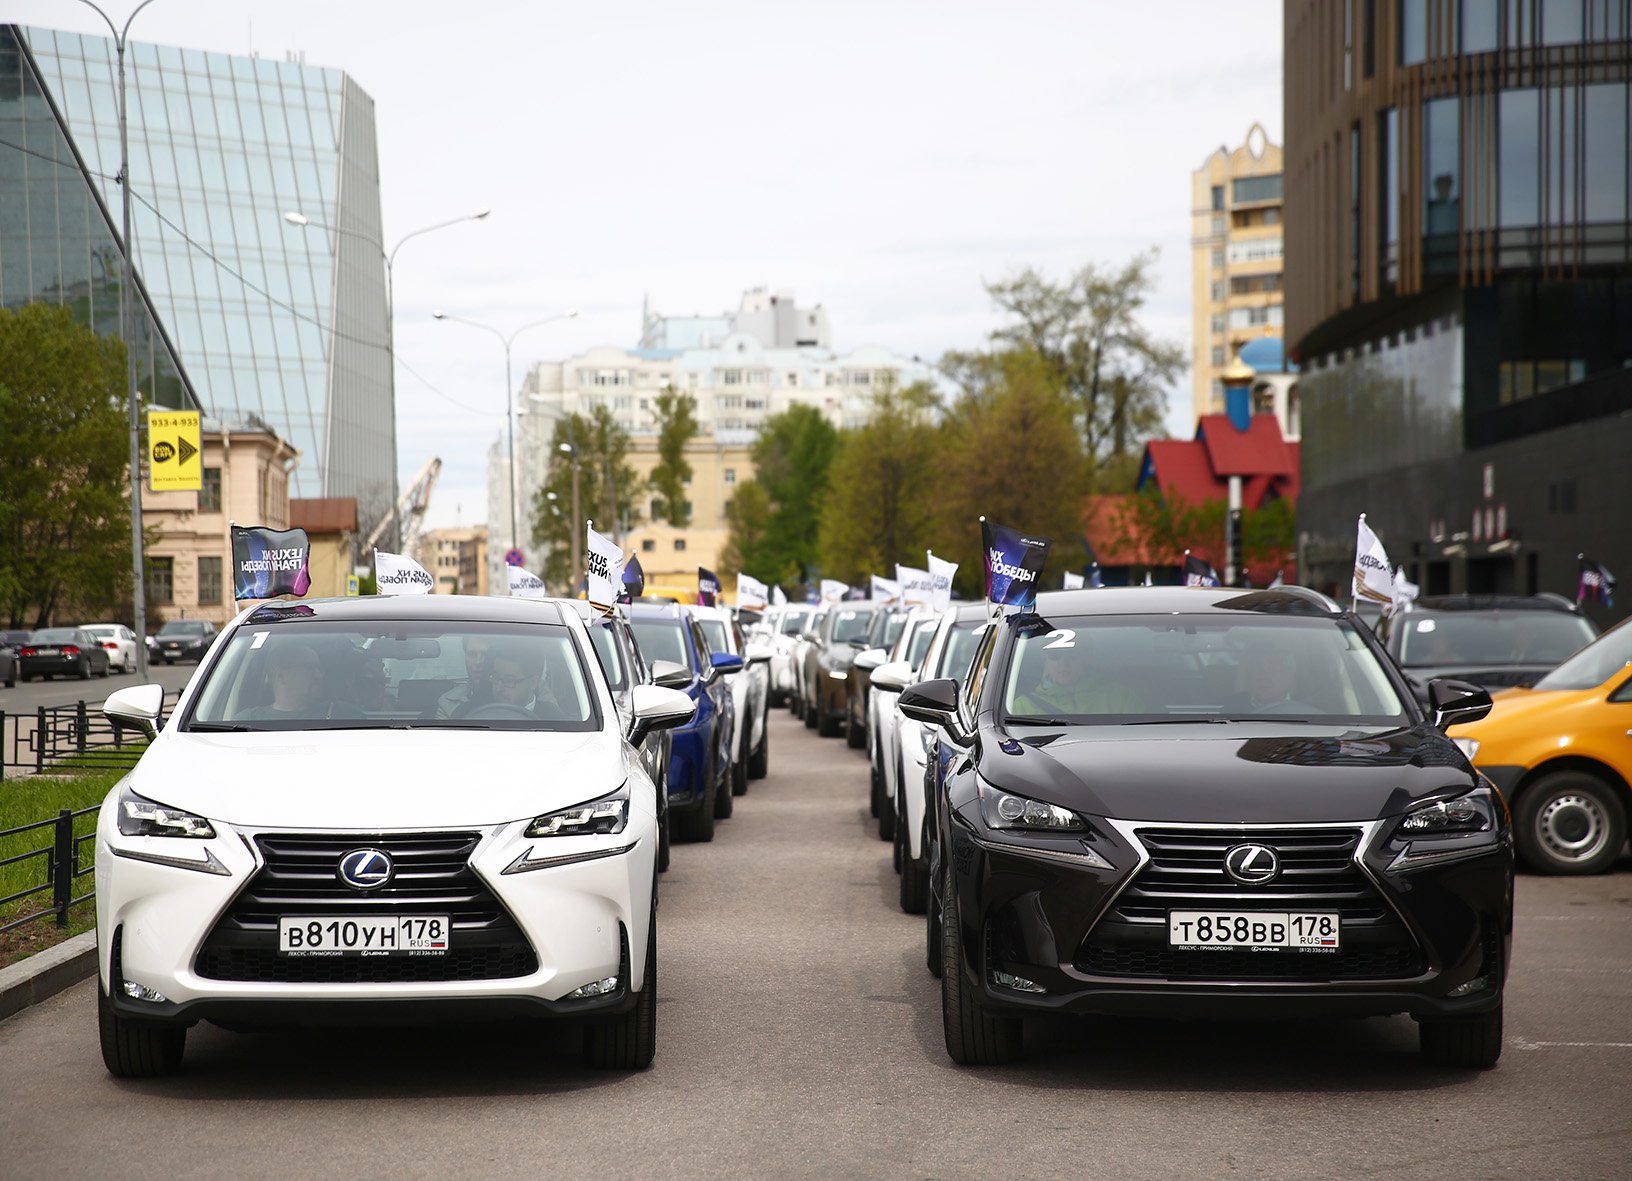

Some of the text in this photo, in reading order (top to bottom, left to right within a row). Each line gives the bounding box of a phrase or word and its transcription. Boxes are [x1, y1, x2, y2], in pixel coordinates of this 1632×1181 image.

[151, 418, 199, 427] 933-4-933
[990, 561, 1036, 582] ПОБЕДЫ
[250, 631, 271, 650] 1
[1042, 628, 1076, 649] 2
[401, 919, 441, 939] 178
[1291, 916, 1332, 937] 178
[1300, 937, 1320, 945] RUS
